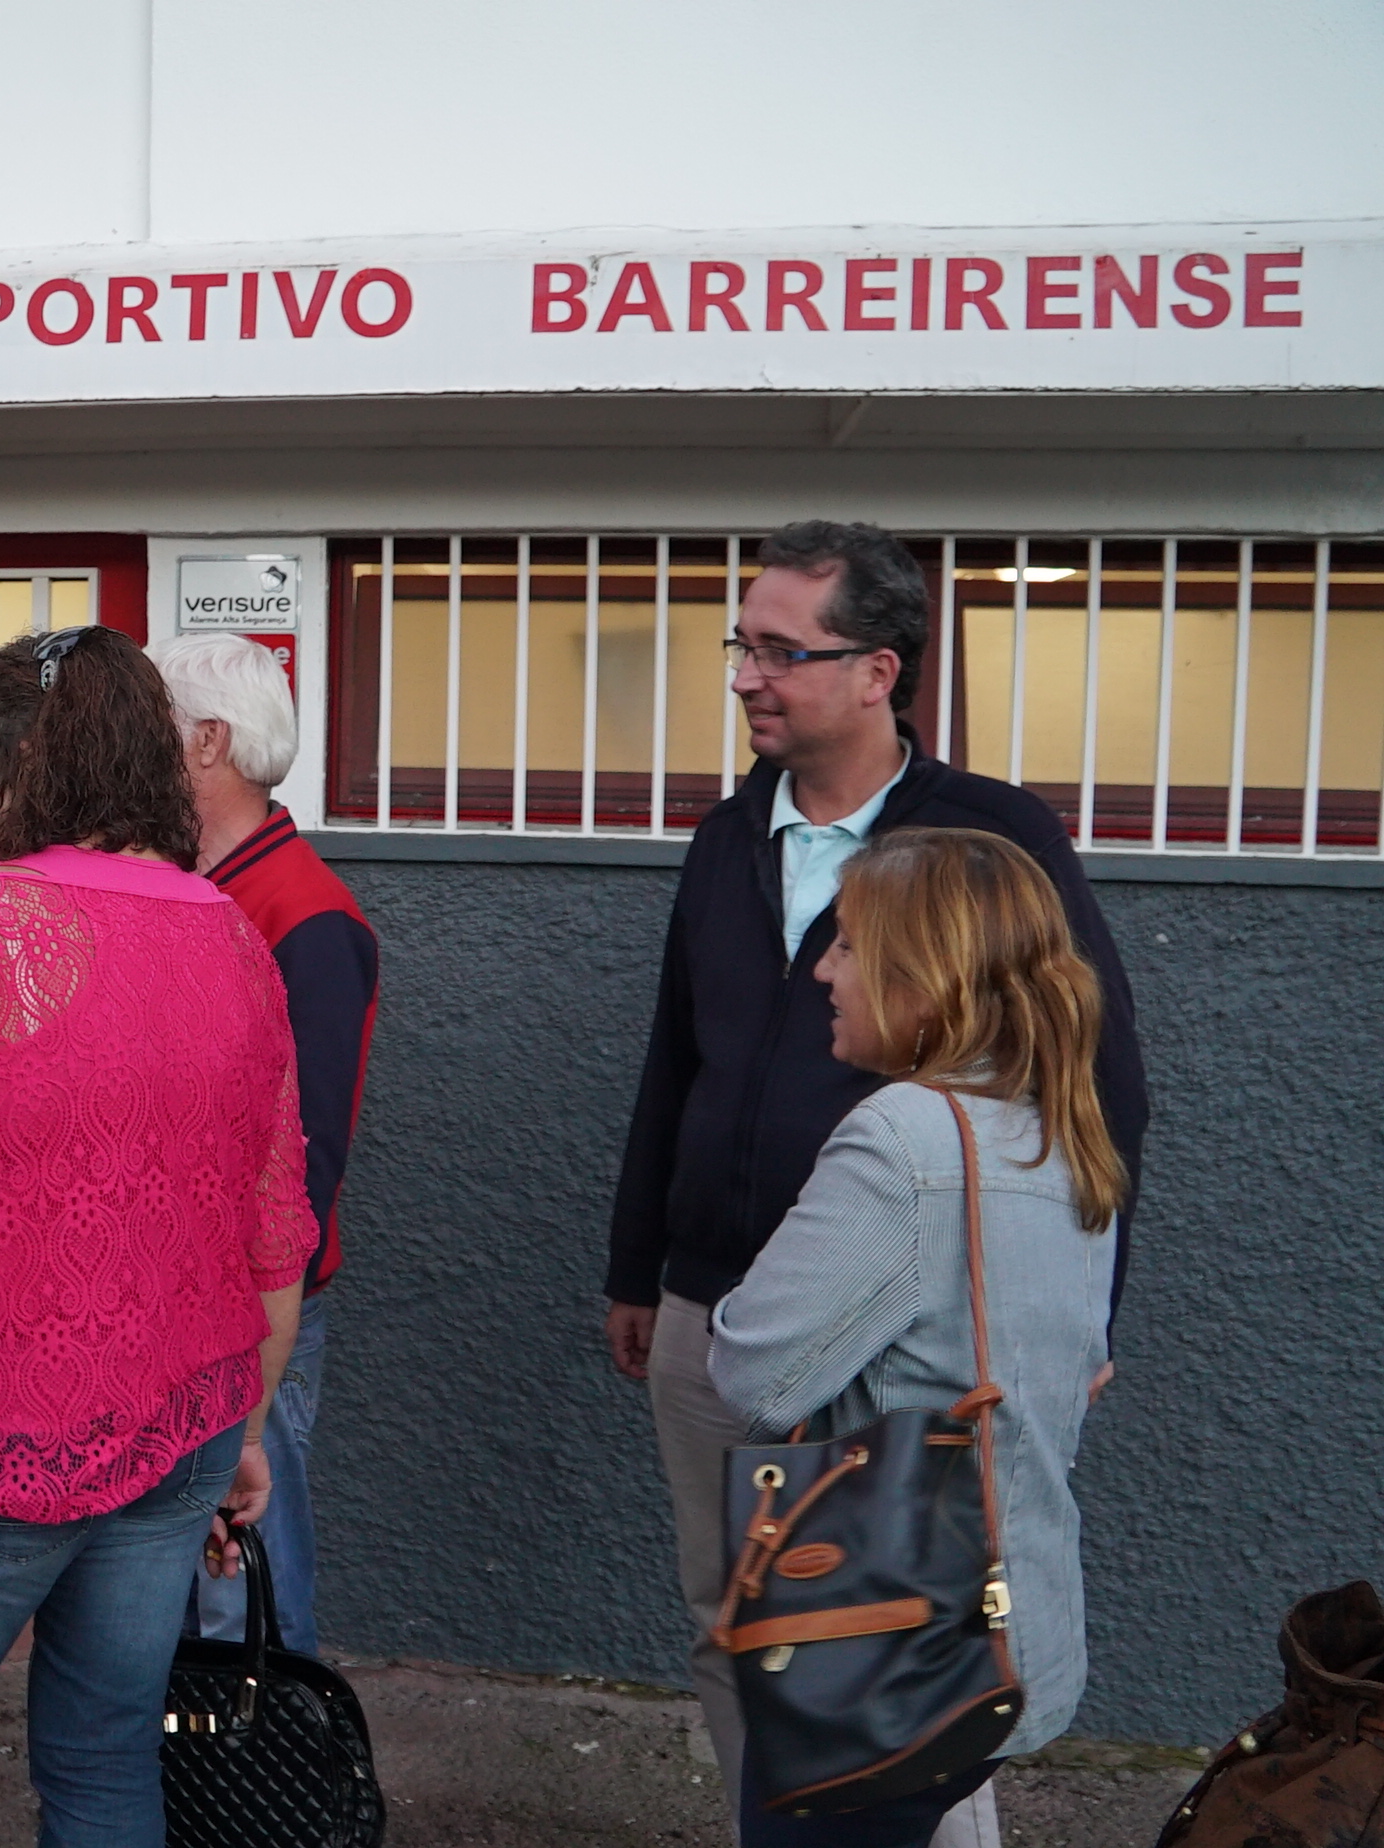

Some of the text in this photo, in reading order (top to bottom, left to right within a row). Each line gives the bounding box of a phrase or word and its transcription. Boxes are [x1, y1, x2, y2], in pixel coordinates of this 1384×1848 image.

[530, 252, 1304, 333] BARREIRENSE
[185, 596, 291, 613] verisure
[189, 615, 287, 626] Alarme Alta Segurança
